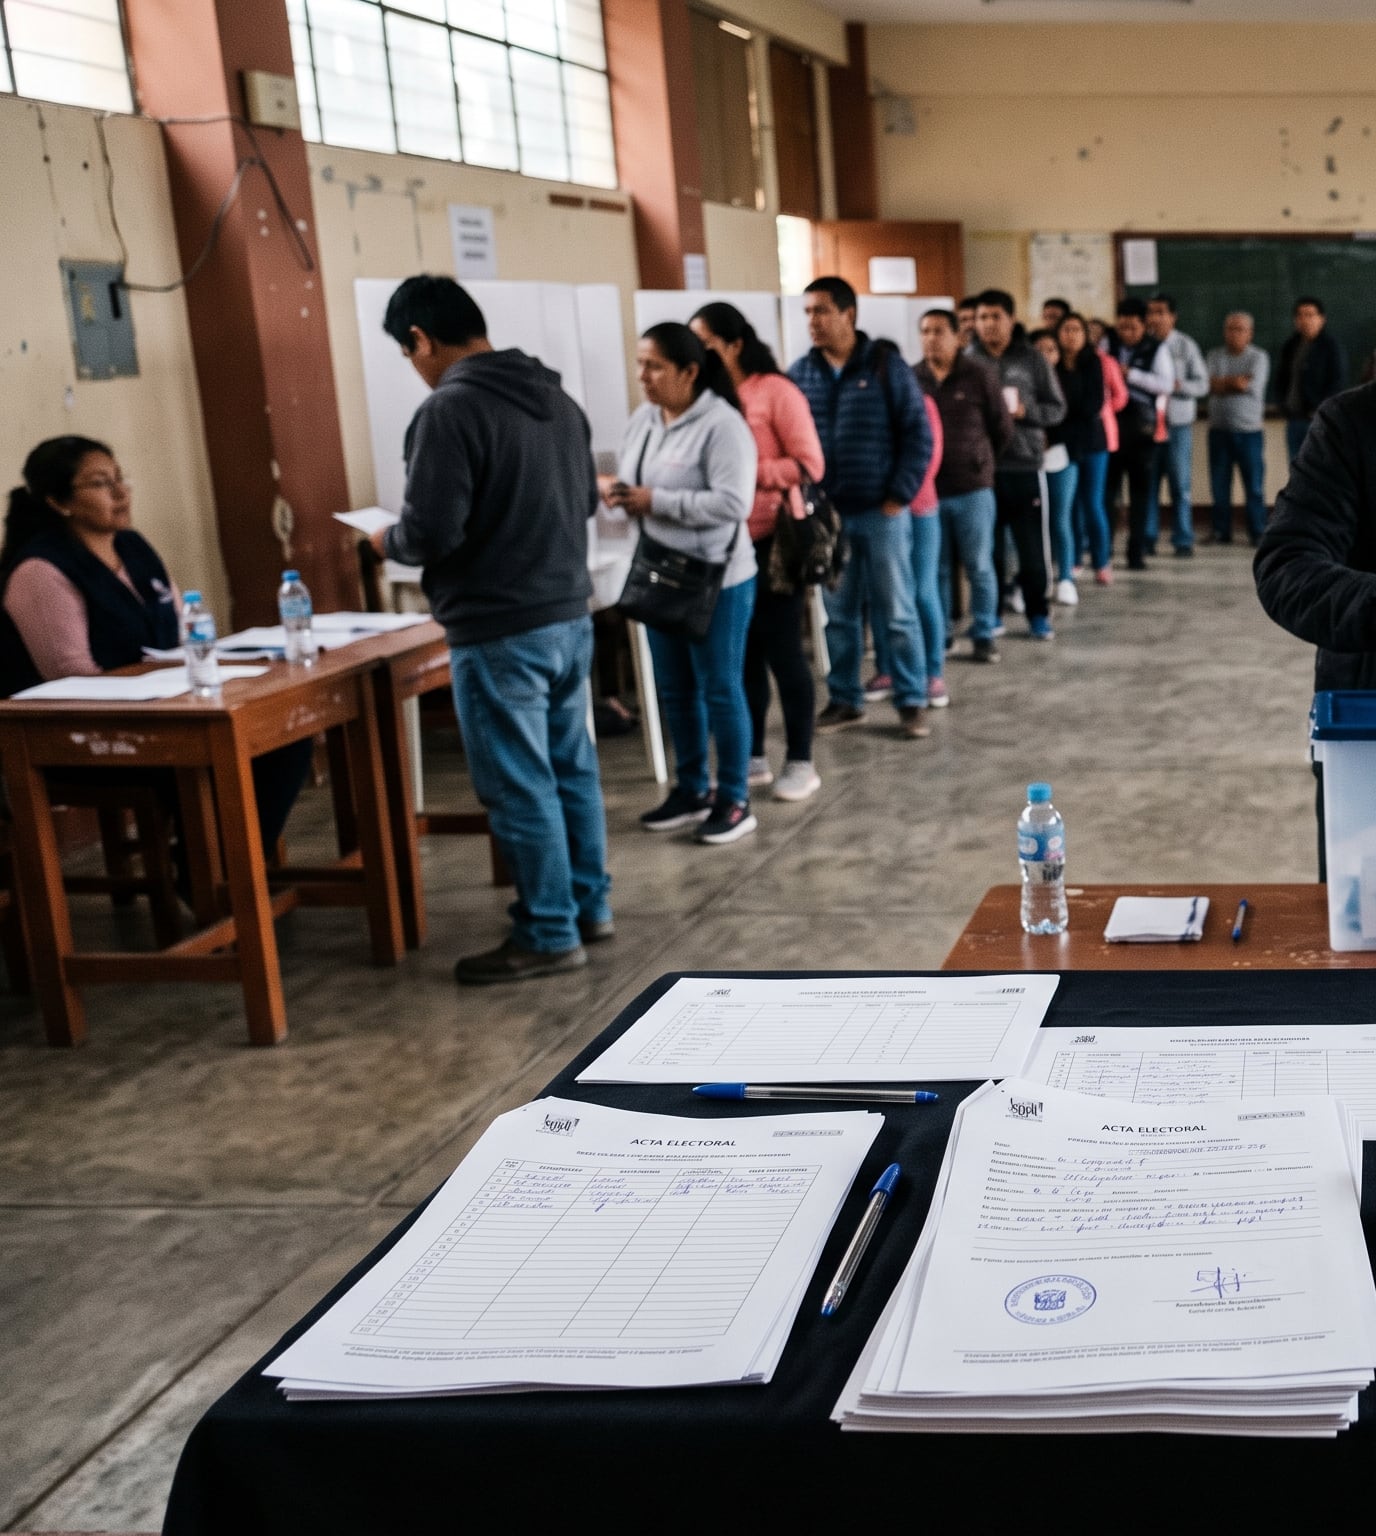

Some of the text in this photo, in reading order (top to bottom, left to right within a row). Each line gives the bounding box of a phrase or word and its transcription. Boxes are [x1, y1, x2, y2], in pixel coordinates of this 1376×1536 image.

[1101, 1124, 1208, 1134] ACTA ELECTORAL
[630, 1138, 738, 1147] ACTA ELECTORAL
